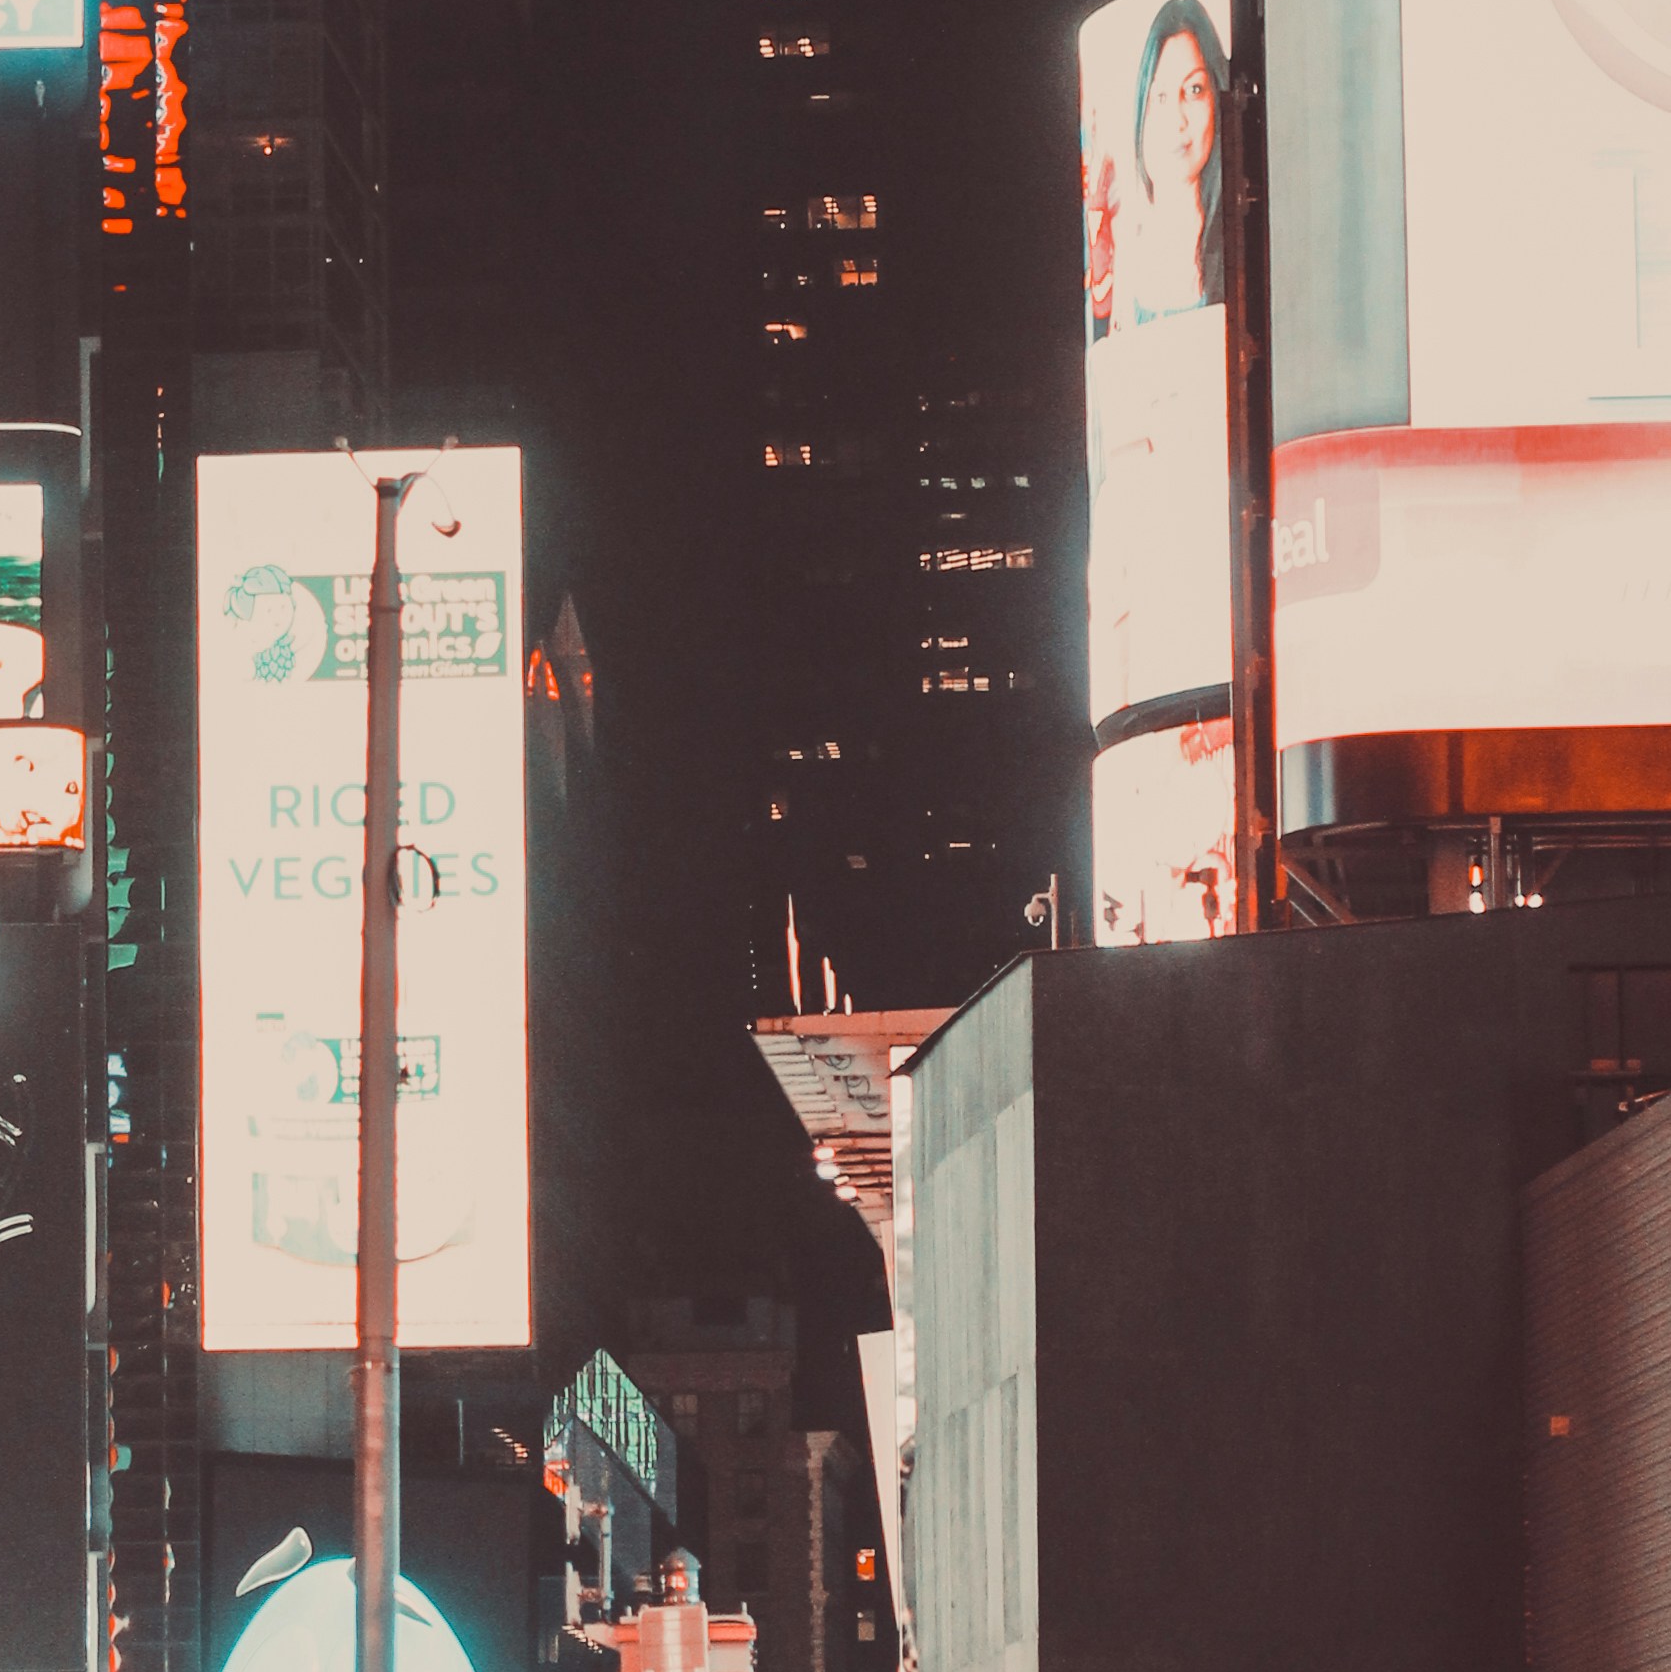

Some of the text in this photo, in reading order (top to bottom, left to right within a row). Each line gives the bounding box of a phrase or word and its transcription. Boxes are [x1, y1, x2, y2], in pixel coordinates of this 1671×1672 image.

[1271, 496, 1329, 579] eal
[409, 574, 496, 603] Green
[333, 604, 499, 636] SPOUT'S
[334, 631, 473, 664] ornics
[228, 852, 500, 901] VEGIES
